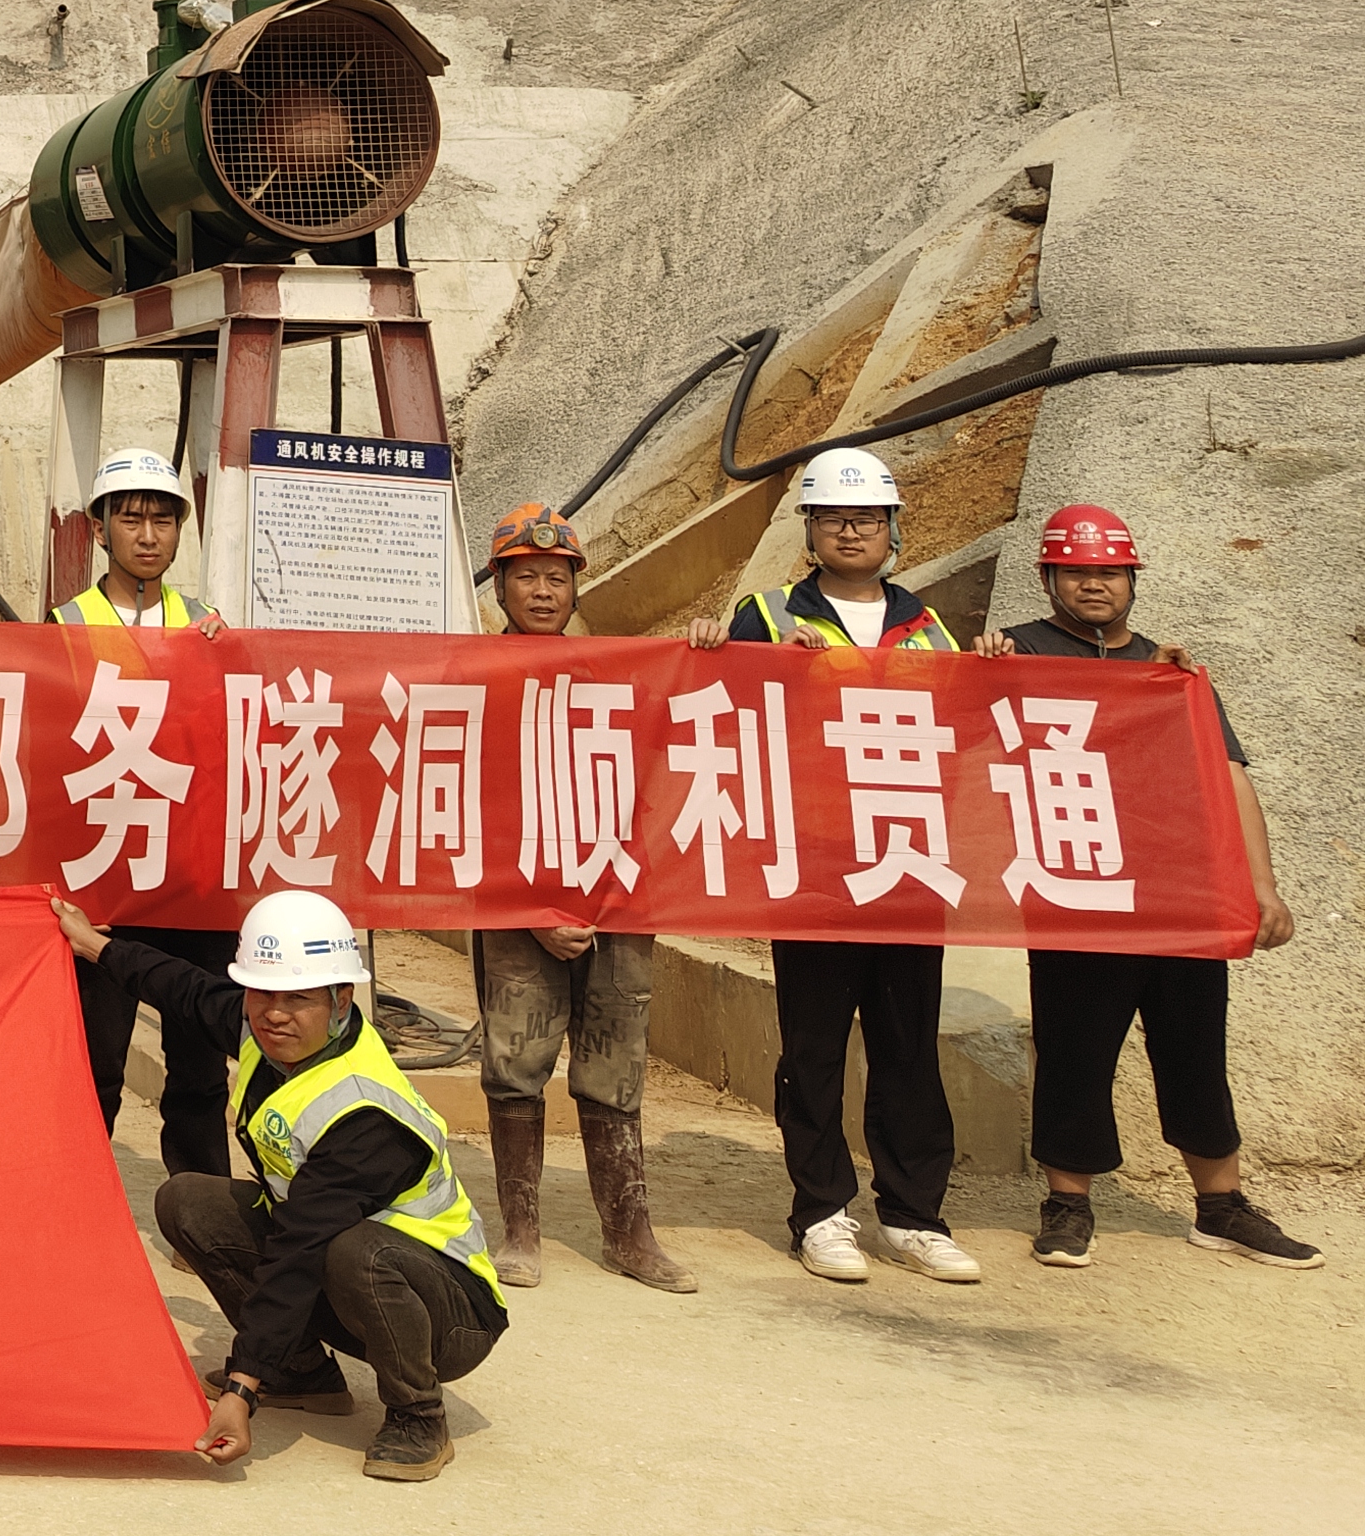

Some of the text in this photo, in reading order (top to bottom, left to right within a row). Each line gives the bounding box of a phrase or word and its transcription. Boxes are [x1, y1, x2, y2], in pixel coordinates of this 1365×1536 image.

[276, 439, 426, 469] 通风机安全操作规程
